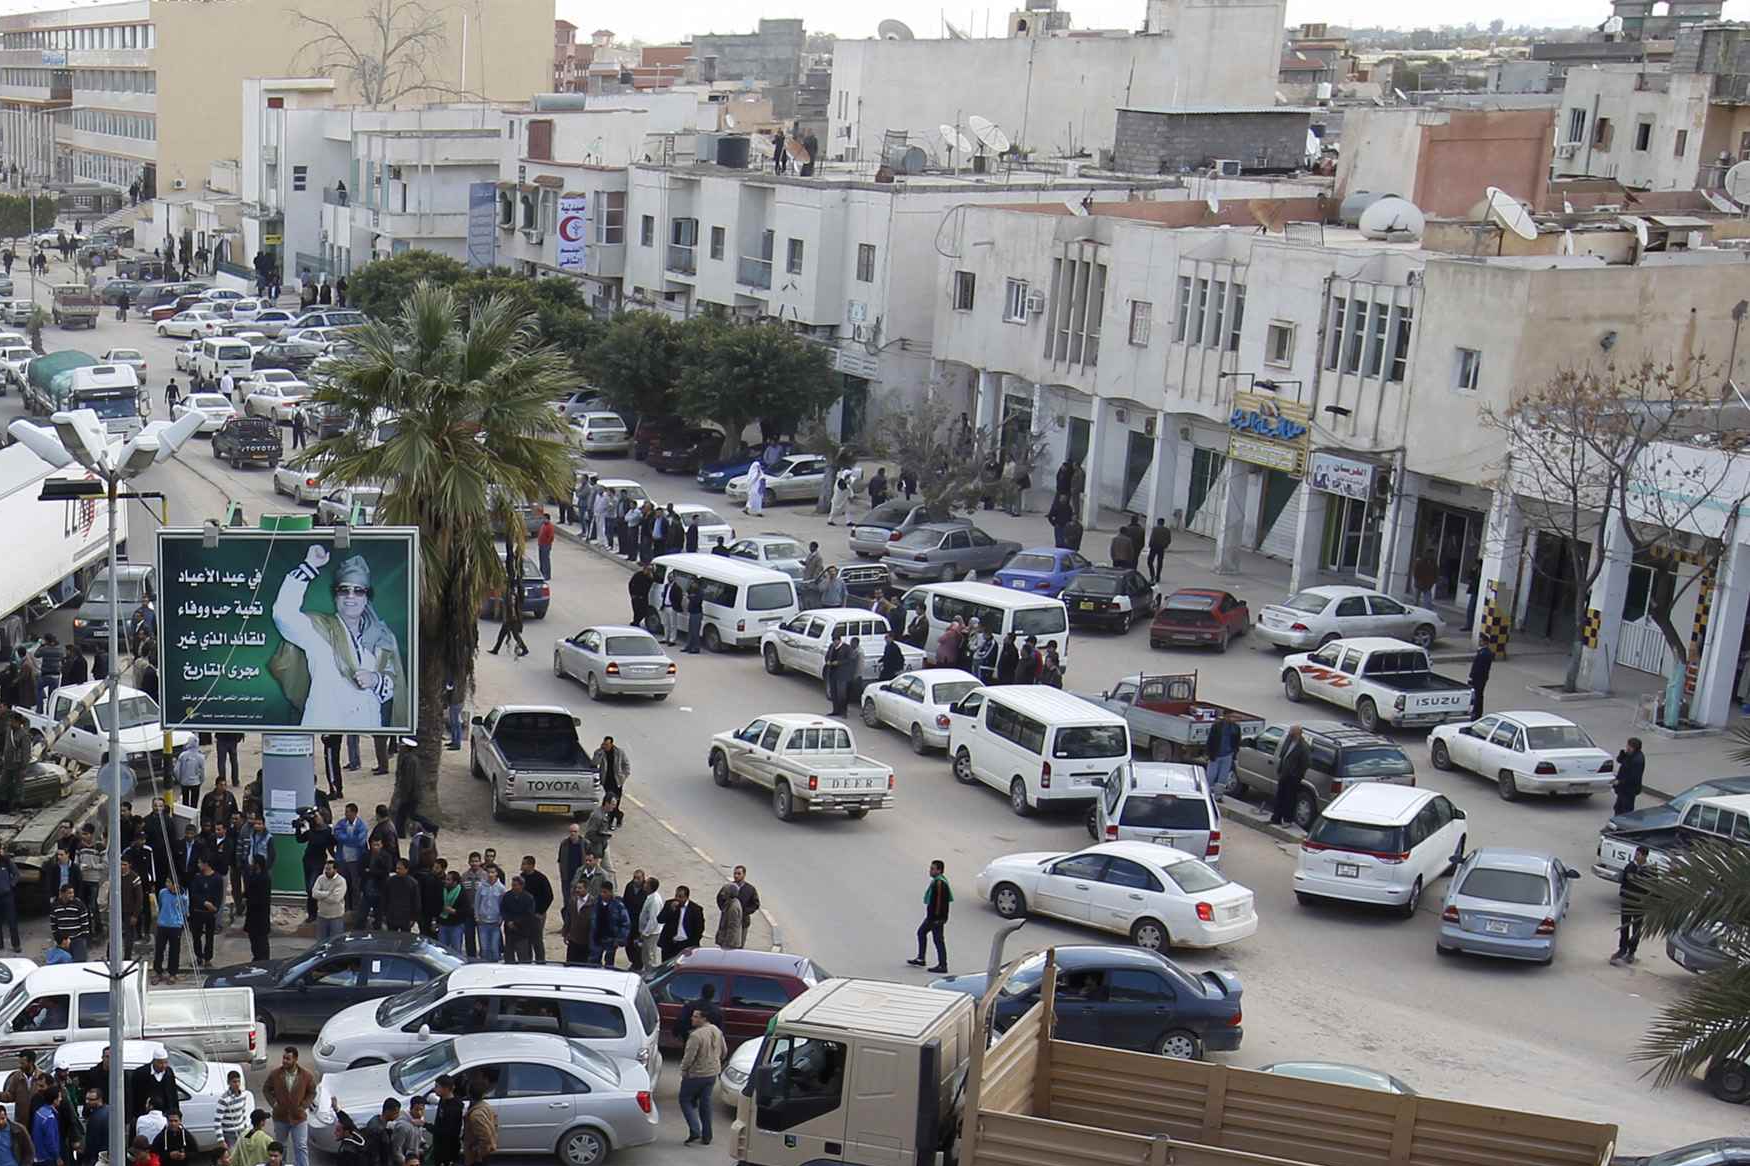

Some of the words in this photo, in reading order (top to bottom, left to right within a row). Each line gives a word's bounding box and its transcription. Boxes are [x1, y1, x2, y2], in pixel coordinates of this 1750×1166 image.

[245, 445, 277, 453] TOYOTA
[222, 571, 246, 587] عيد
[248, 568, 262, 590] في
[178, 600, 211, 619] ووفاء
[212, 604, 231, 619] حب
[234, 600, 264, 619] تحية
[176, 631, 198, 649] غير
[200, 631, 227, 650] الذي
[230, 631, 266, 645] للقائد
[183, 661, 226, 680] التاريخ
[228, 664, 260, 680] مجرى
[1416, 696, 1461, 707] ISUZU
[527, 781, 581, 791] TOYOTA
[832, 779, 873, 789] DEER
